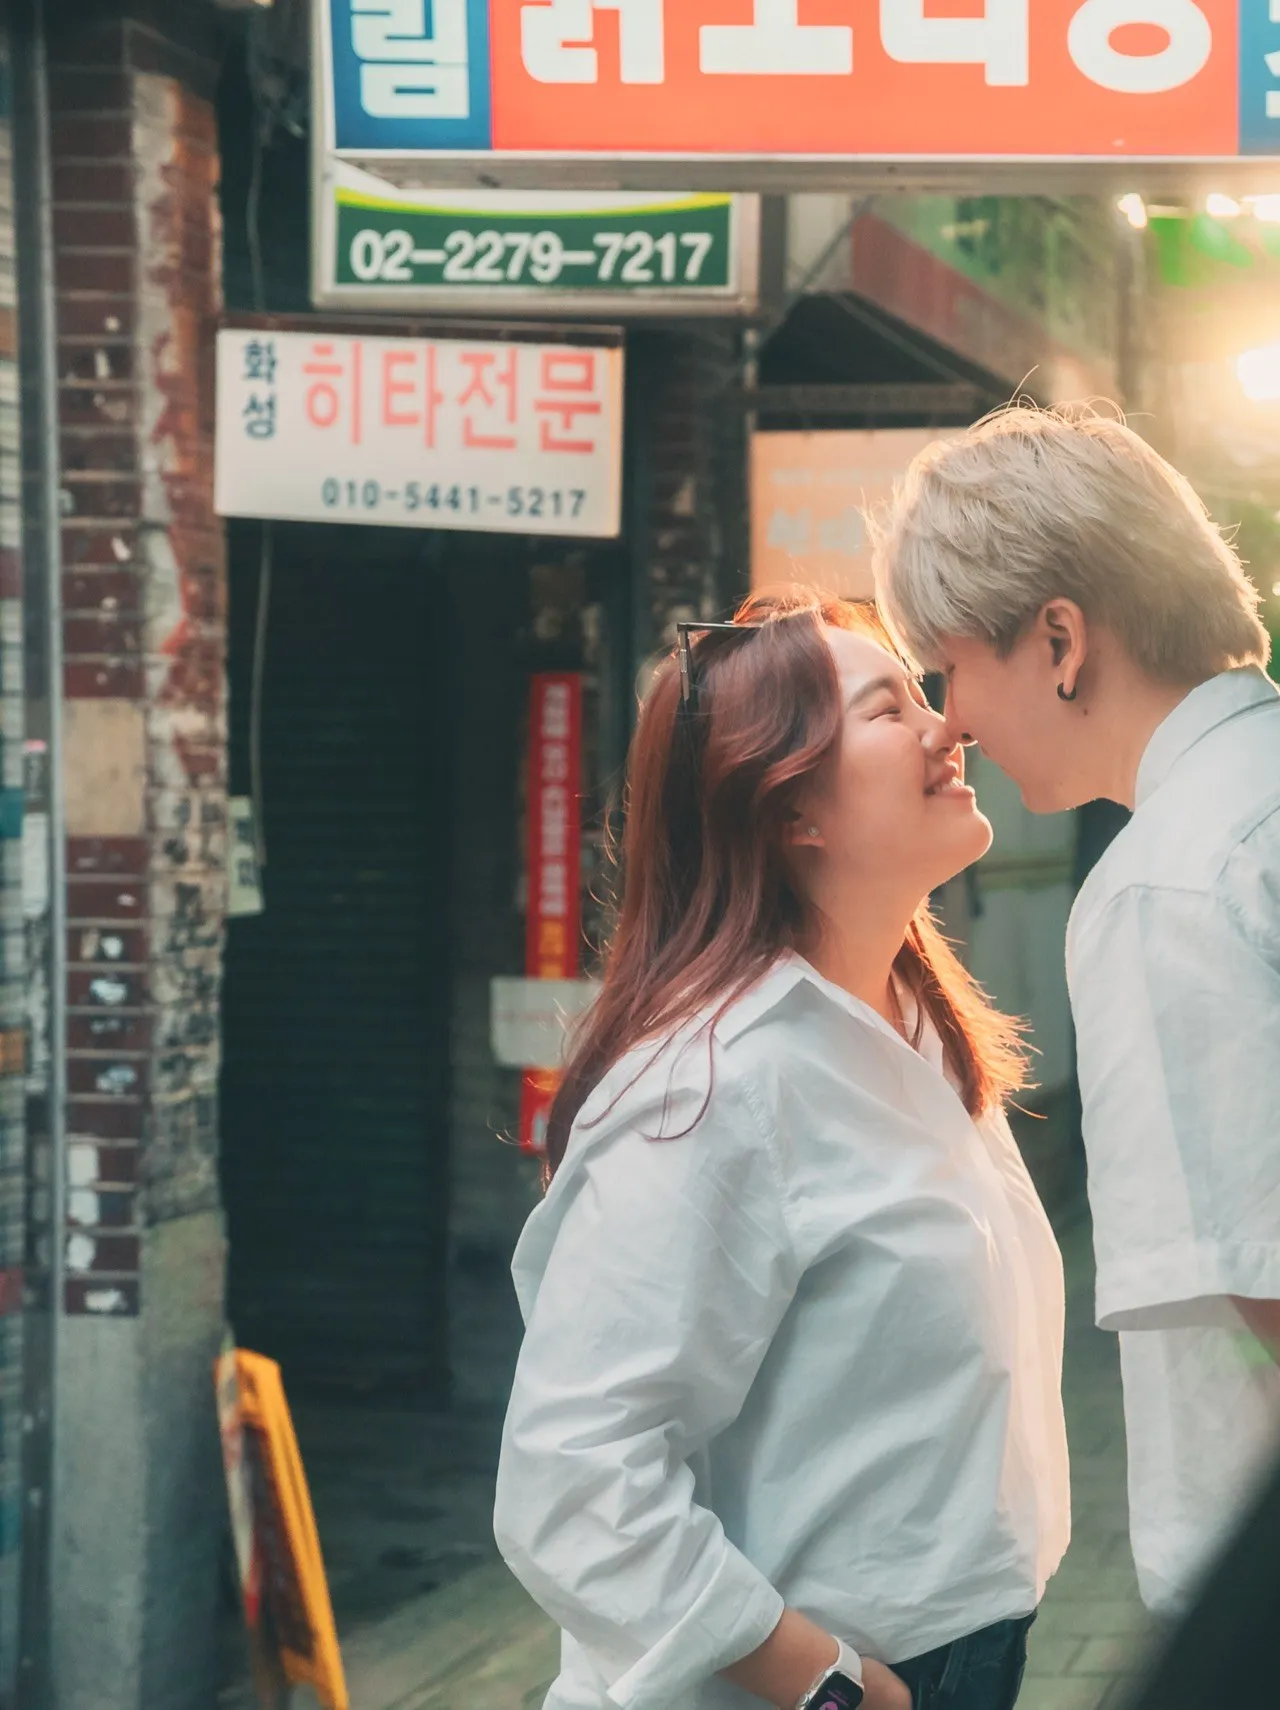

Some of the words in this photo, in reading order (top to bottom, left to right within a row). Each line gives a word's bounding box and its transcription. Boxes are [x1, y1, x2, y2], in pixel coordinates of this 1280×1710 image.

[350, 229, 713, 282] 02-2279-7217
[241, 338, 280, 441] 화성
[302, 341, 603, 455] 히타전문
[321, 477, 588, 519] 010-5441-5217
